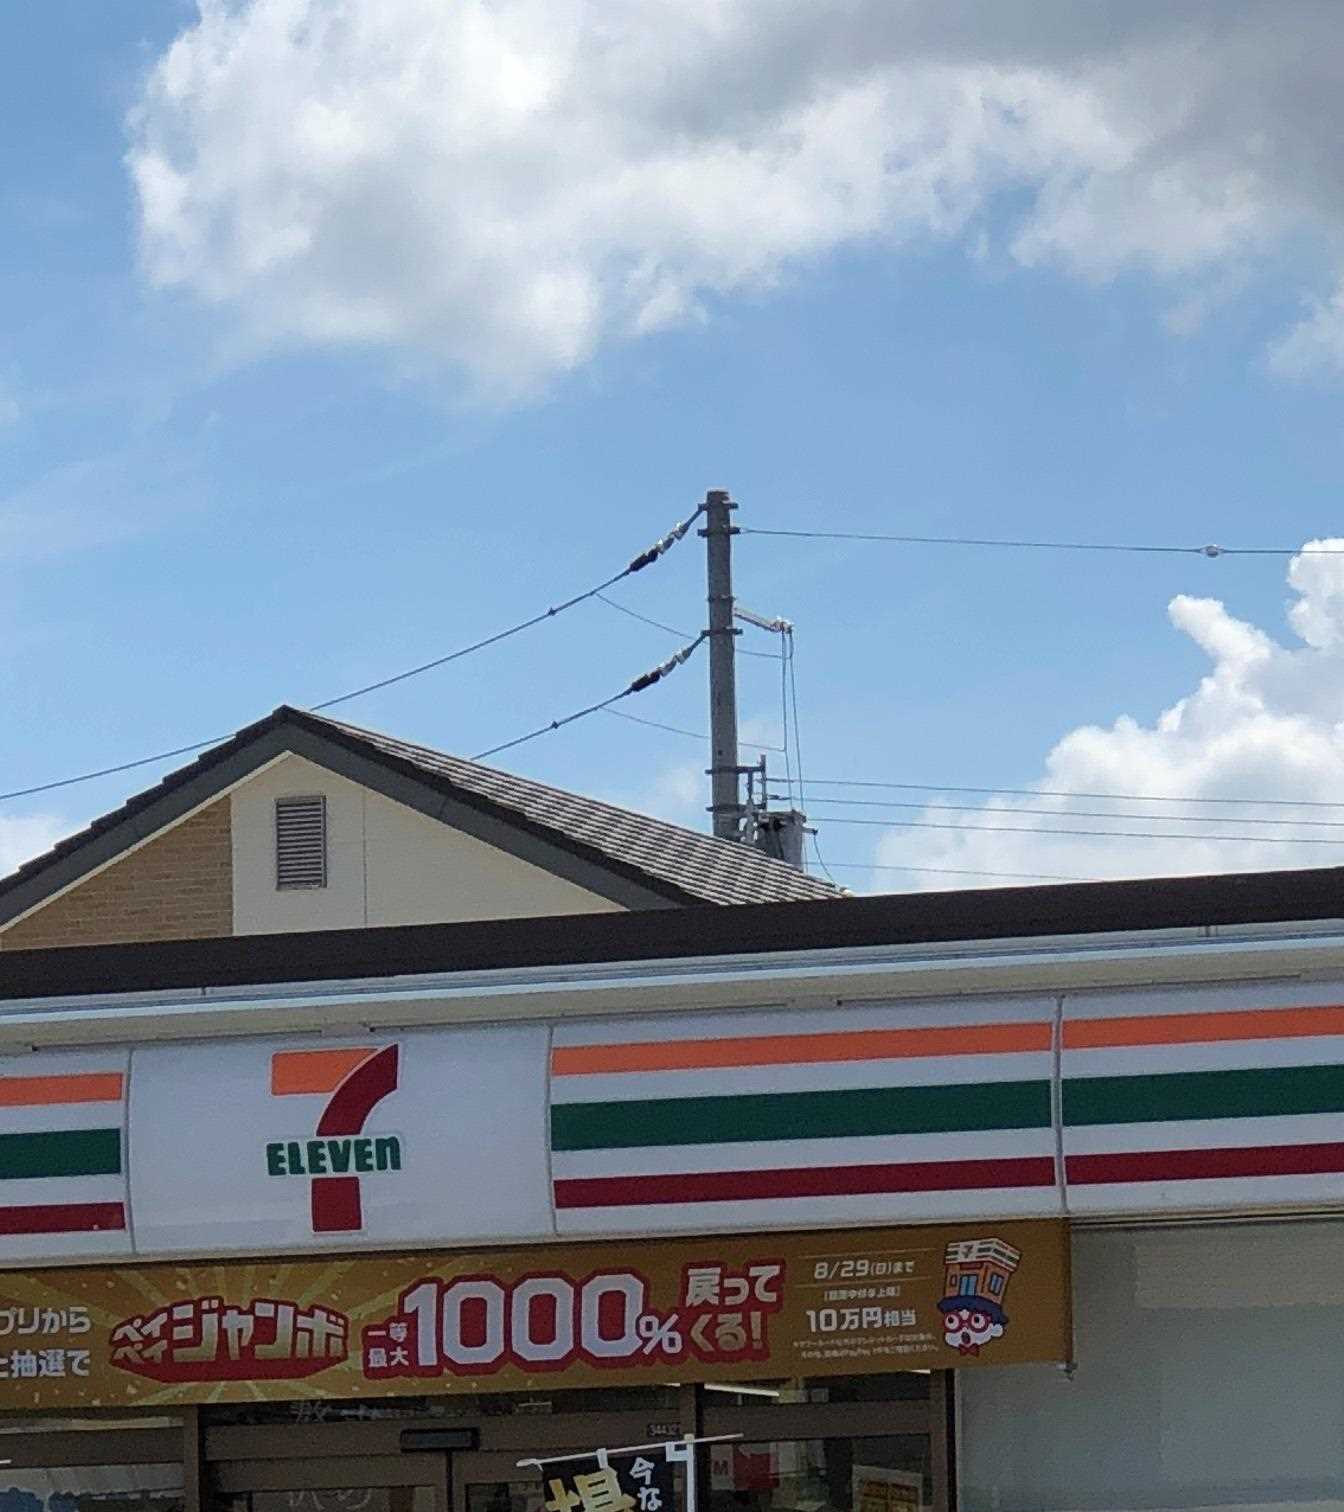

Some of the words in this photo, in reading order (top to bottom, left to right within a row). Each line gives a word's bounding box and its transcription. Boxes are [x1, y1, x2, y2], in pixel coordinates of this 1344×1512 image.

[684, 1265, 781, 1308] 戻って
[805, 1307, 917, 1333] 10万円相当
[368, 1346, 409, 1369] 最大
